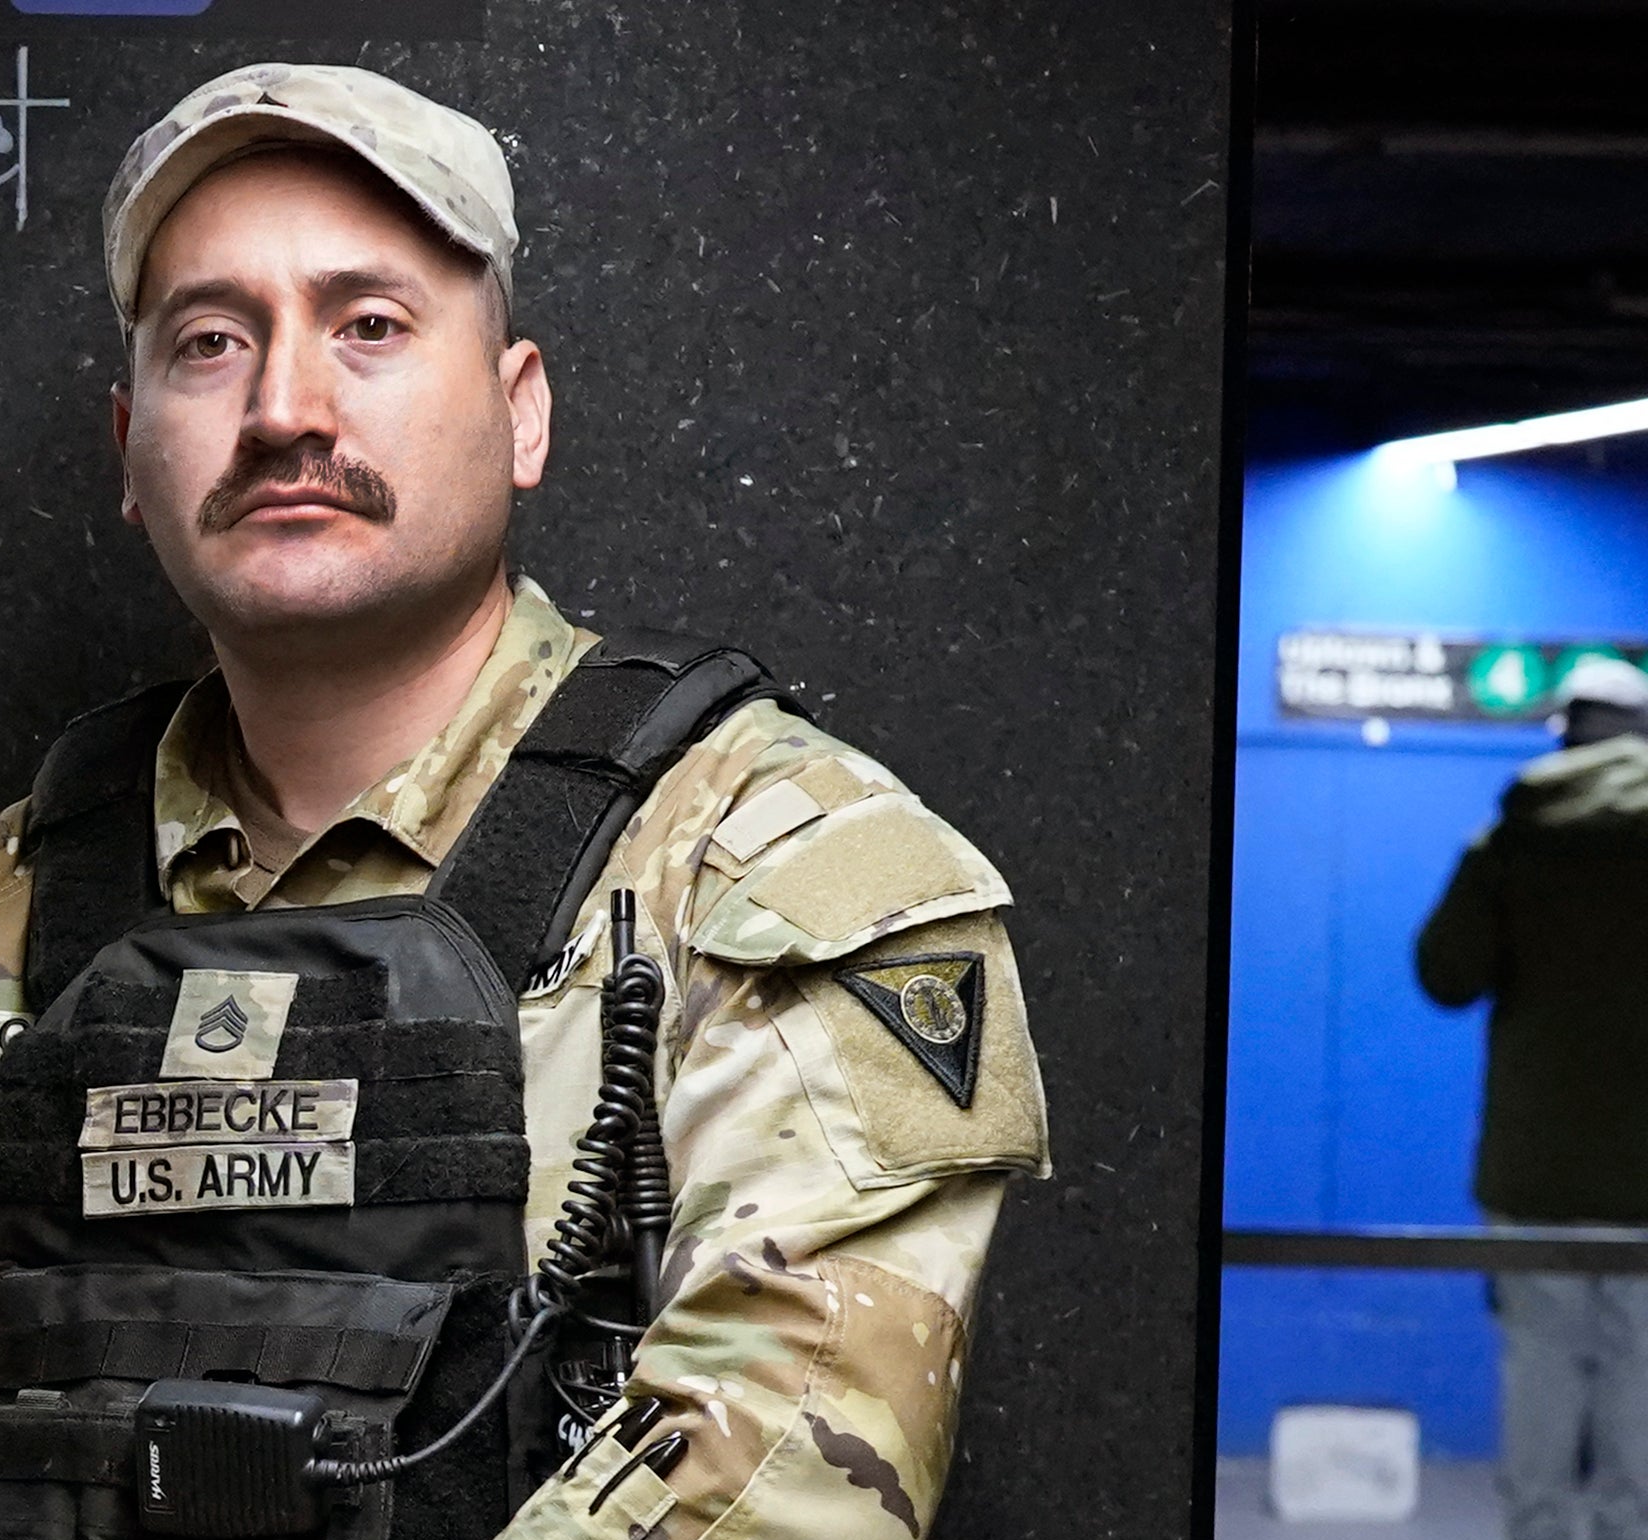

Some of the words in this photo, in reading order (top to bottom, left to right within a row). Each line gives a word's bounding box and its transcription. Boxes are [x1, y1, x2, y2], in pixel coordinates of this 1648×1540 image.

[1484, 650, 1526, 704] 4
[115, 1088, 320, 1134] EBBECKE
[111, 1158, 182, 1205] U.S.
[197, 1152, 322, 1199] ARMY
[148, 1440, 168, 1501] HARRIS
